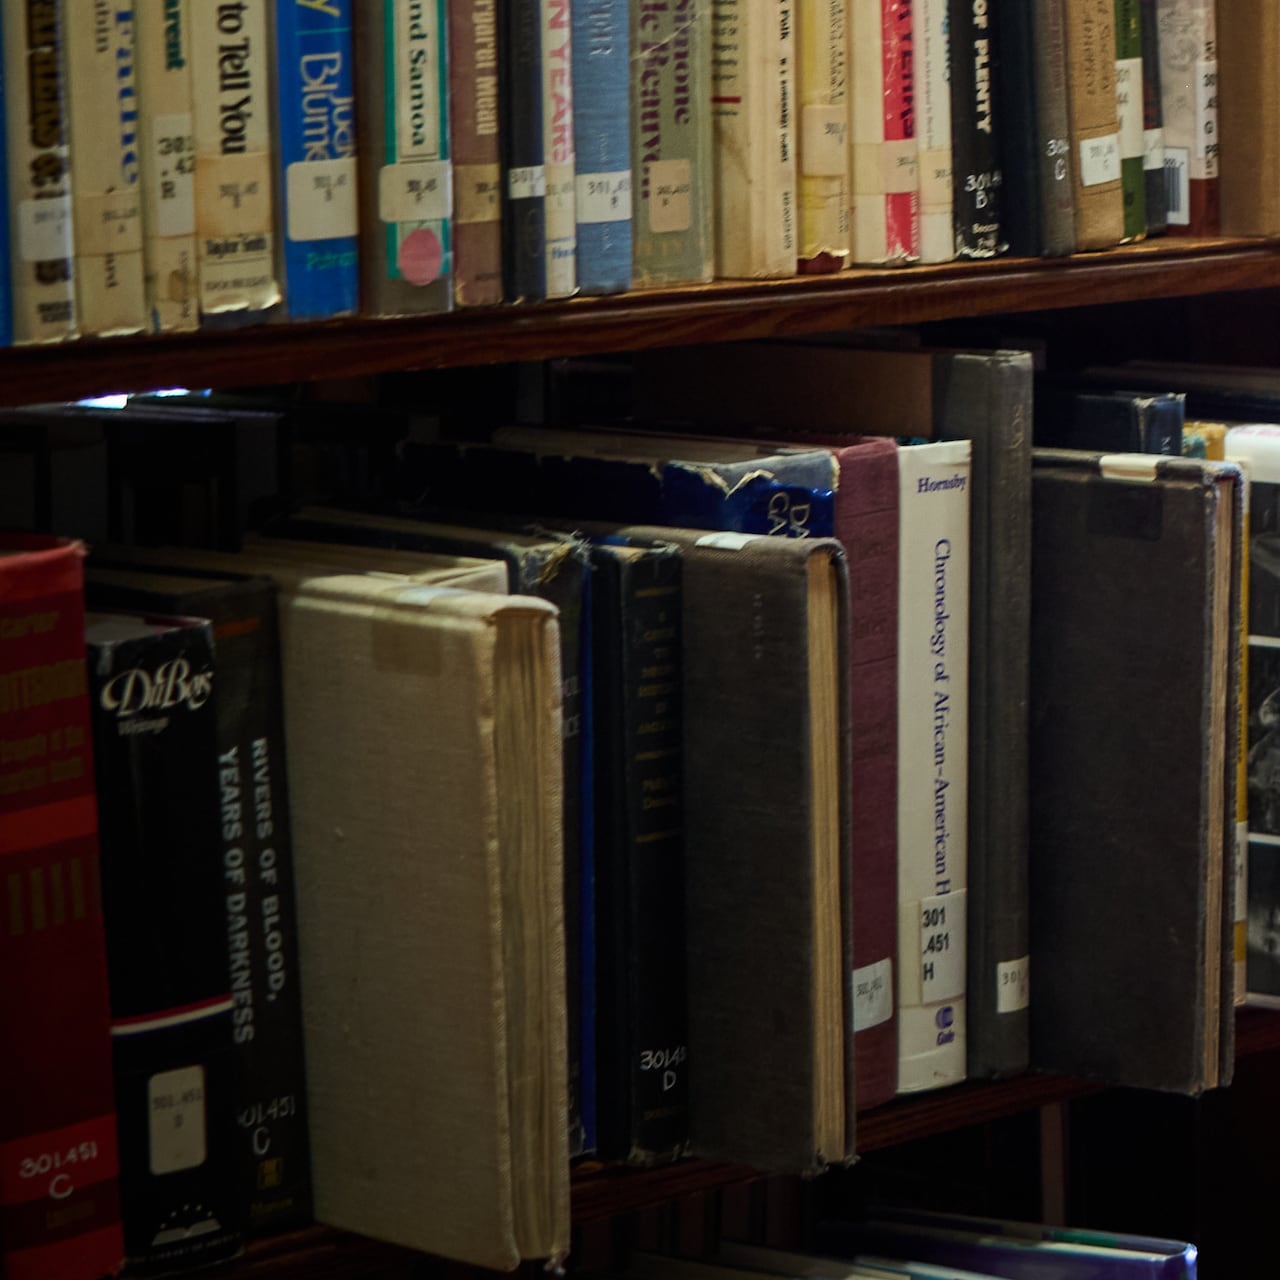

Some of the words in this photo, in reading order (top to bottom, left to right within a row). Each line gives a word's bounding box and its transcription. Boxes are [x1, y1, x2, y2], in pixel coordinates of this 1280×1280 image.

[219, 4, 247, 35] to
[780, 11, 791, 41] Folk
[220, 38, 251, 93] Tell
[409, 49, 433, 146] Samoa
[974, 39, 993, 135] PLENTY
[476, 76, 501, 137] Mead
[221, 95, 252, 157] You
[917, 473, 967, 494] Hornsby
[930, 539, 952, 658] Chronology
[934, 664, 950, 682] of
[217, 745, 244, 841] YEARS
[251, 735, 275, 840] RIVERS
[933, 691, 952, 880] African-American
[223, 847, 247, 885] OF
[257, 848, 279, 886] OF
[923, 907, 946, 928] 301
[261, 895, 288, 1002] BLOOD,
[923, 932, 950, 956] .451
[225, 892, 256, 1045] DARKNESS
[923, 962, 935, 981] H
[663, 1070, 676, 1092] D
[253, 1126, 272, 1157] C
[49, 1172, 75, 1200] C
